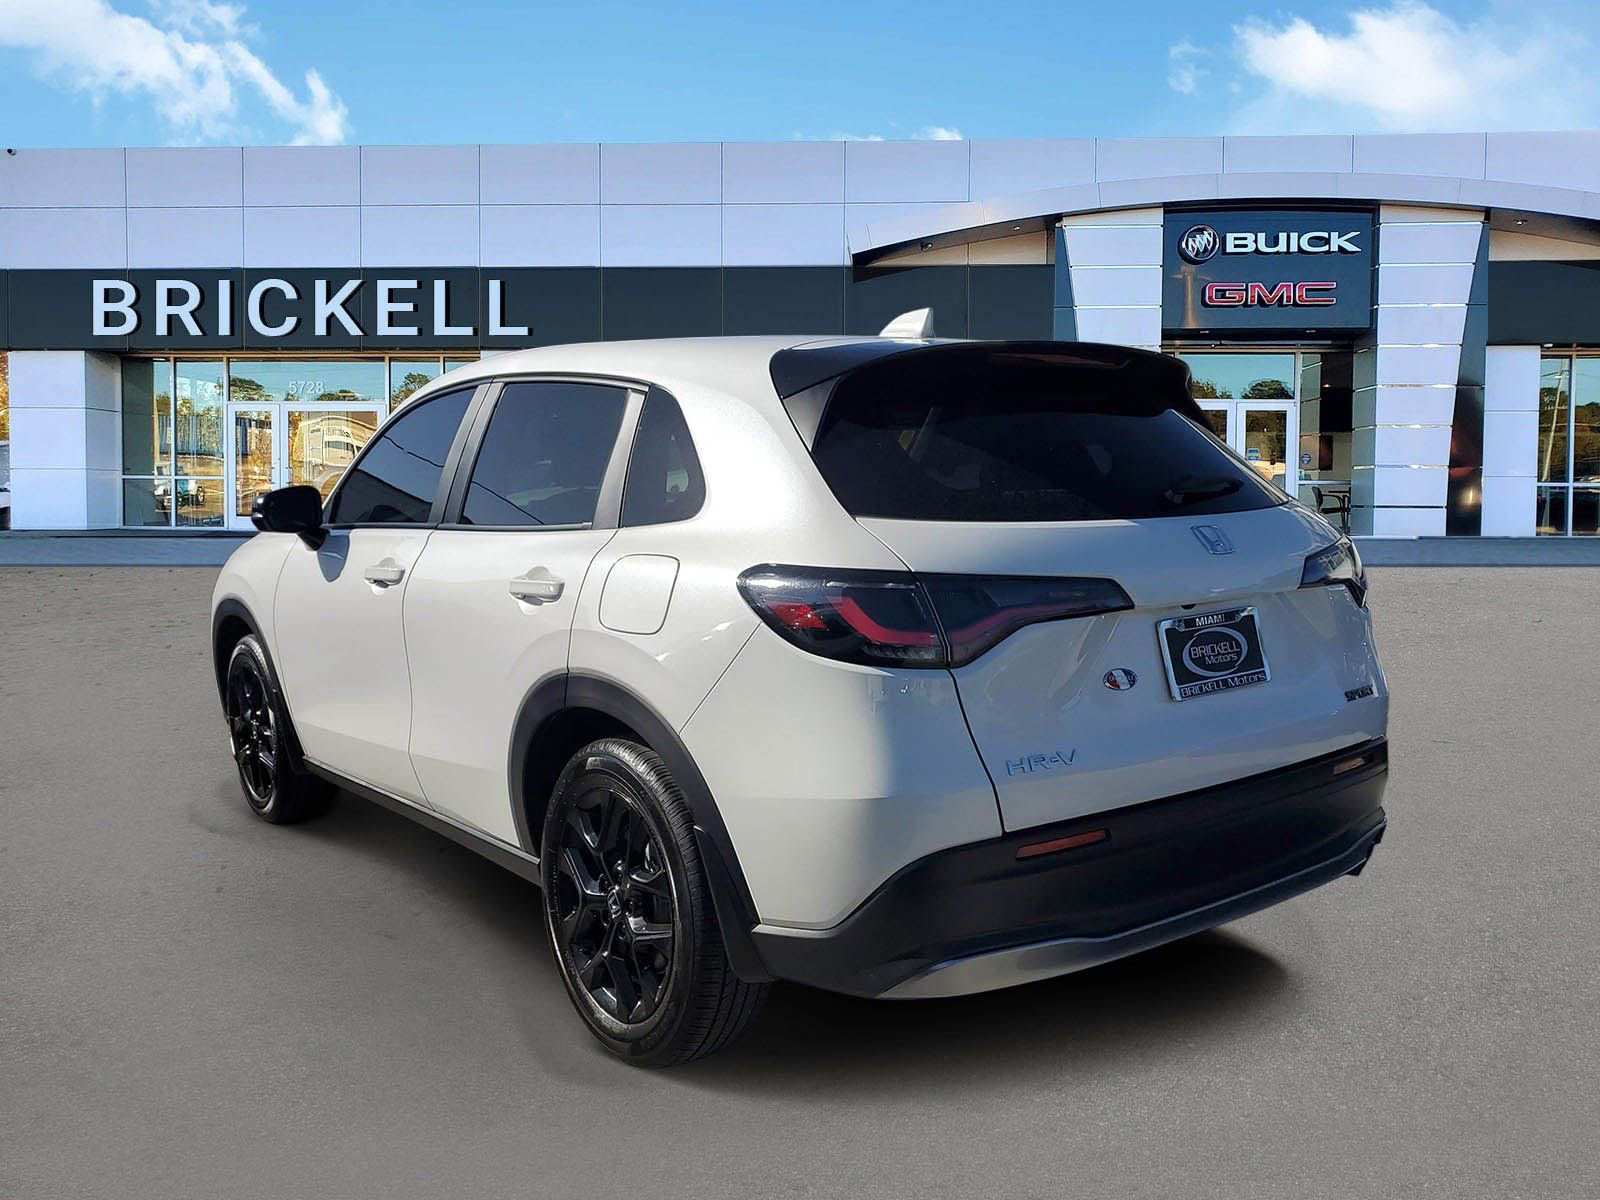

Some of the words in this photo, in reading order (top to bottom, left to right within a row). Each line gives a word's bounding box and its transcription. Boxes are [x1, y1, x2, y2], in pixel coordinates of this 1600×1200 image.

[1225, 231, 1362, 253] BUICK
[1205, 281, 1338, 305] GMC
[92, 279, 530, 337] BRICKELL
[288, 380, 325, 395] 5728
[1195, 614, 1225, 627] MIAMI
[1191, 641, 1240, 658] BRICKELL
[1205, 653, 1238, 665] Motors
[1181, 681, 1226, 697] BRICKELL
[1228, 674, 1266, 688] Motors
[1005, 748, 1077, 777] HR-V
